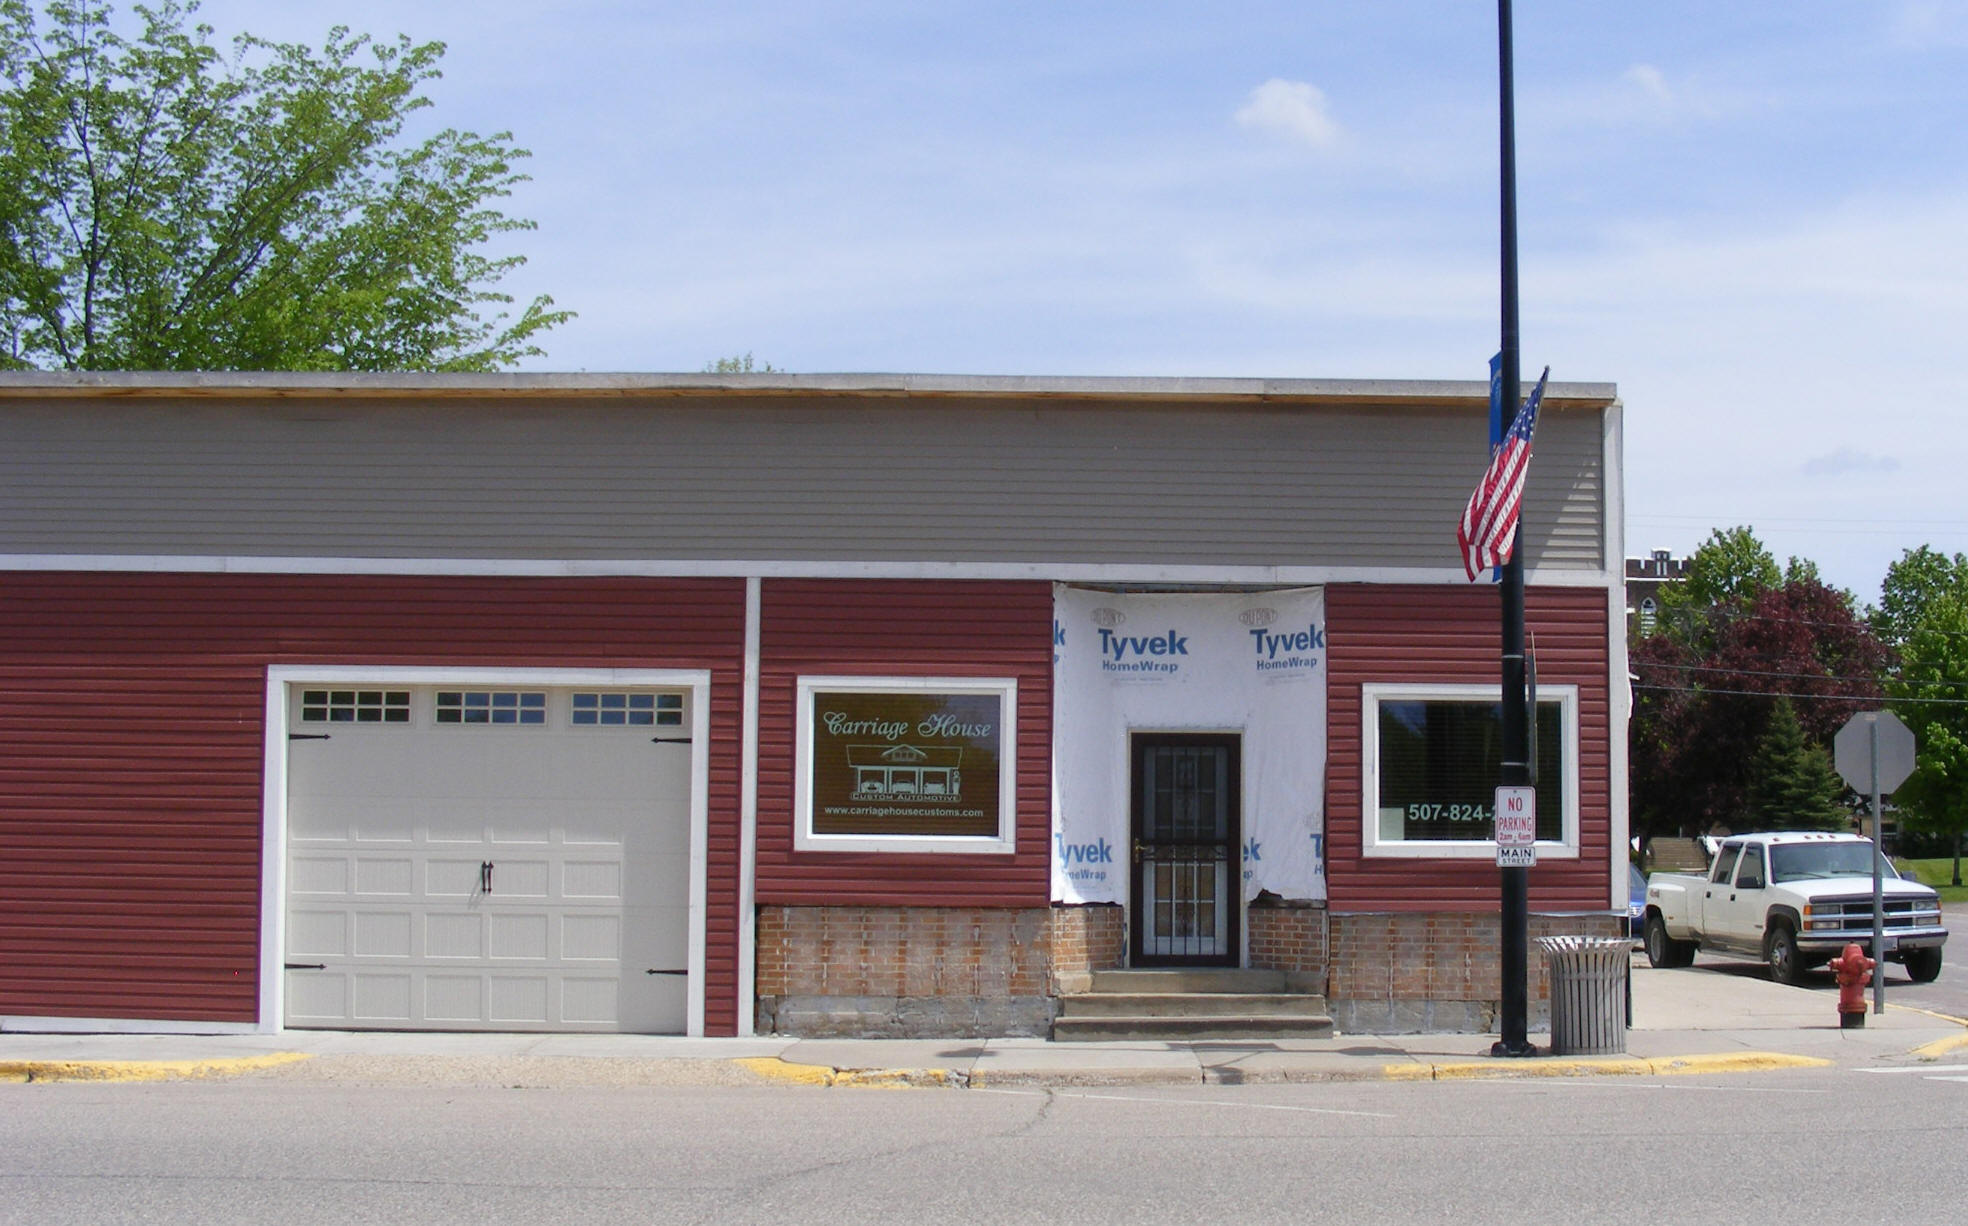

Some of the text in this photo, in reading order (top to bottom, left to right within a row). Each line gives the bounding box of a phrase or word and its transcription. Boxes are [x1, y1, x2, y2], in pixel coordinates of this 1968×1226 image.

[1098, 628, 1189, 661] Tyvek
[1249, 624, 1325, 659] Tyvek
[1102, 660, 1178, 674] HomeWrap
[1256, 657, 1317, 670] HomeWrap
[823, 711, 992, 740] Carriage House
[1507, 797, 1523, 811] NO
[824, 806, 983, 818] www.carriagehousecustoms.com
[1499, 817, 1532, 831] PARKING
[1501, 849, 1531, 857] MAIN
